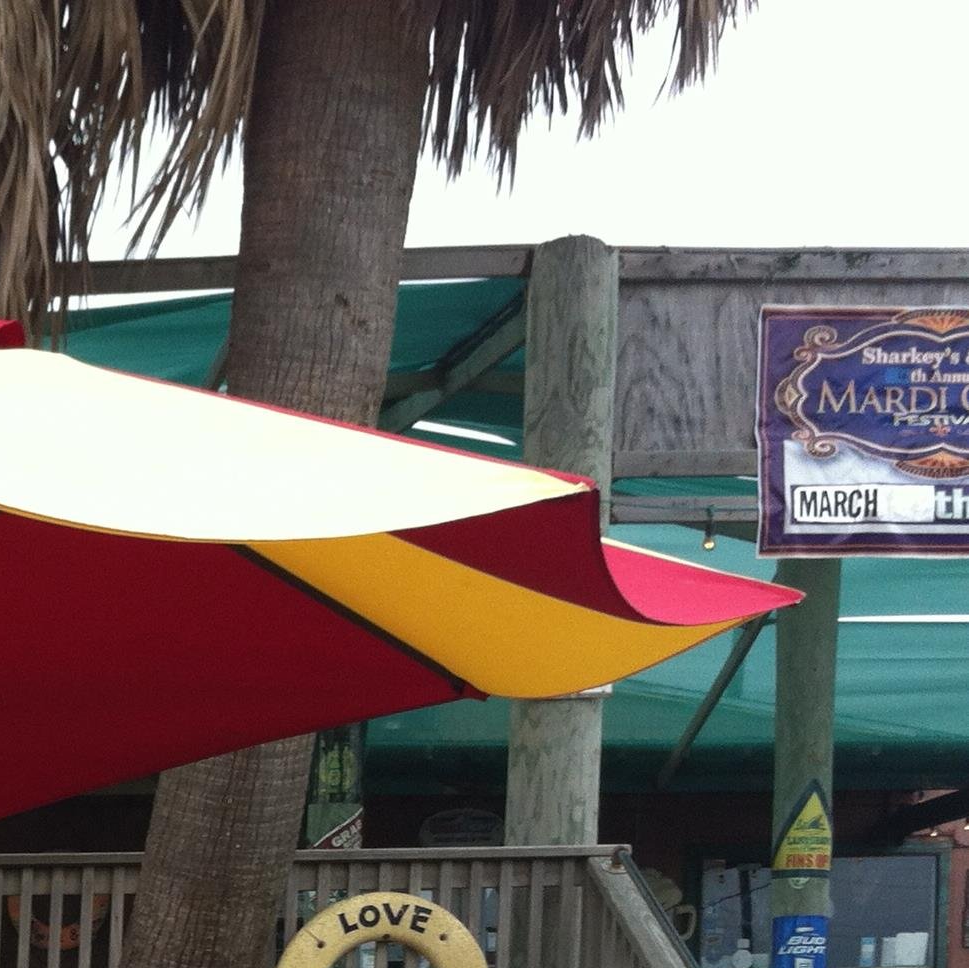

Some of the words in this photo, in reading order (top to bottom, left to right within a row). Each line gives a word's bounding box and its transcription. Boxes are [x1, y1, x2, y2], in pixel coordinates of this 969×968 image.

[862, 347, 960, 368] Sharkey's
[911, 368, 927, 382] th
[816, 379, 948, 414] MARDI
[800, 488, 878, 519] MARCH
[338, 903, 432, 934] LOVE
[777, 946, 827, 955] LIGHT
[787, 935, 827, 945] BUD
